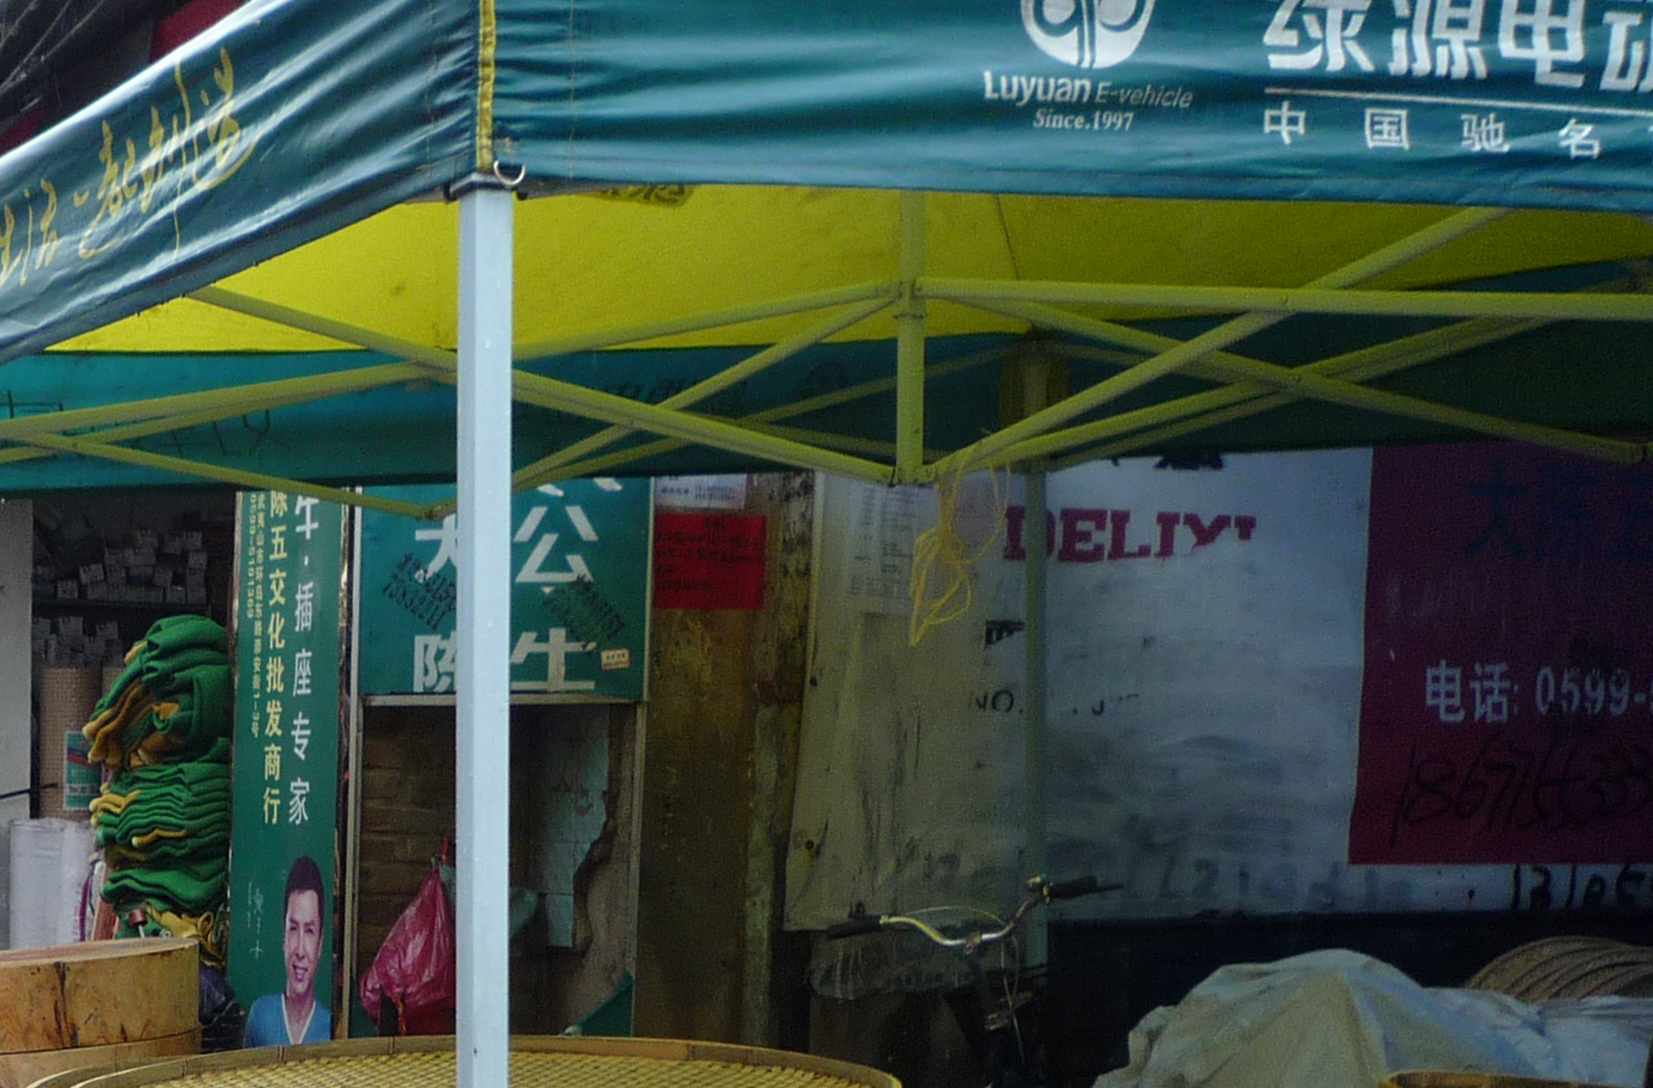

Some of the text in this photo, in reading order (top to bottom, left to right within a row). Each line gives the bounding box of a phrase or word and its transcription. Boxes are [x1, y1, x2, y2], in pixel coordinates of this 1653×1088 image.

[983, 69, 1194, 108] Luyuan E-vehicle
[1033, 108, 1135, 131] Since.1997
[1263, 100, 1602, 160] 中国驰名
[263, 490, 289, 825] 陈五交化批发商行
[1534, 665, 1653, 717] 0599-
